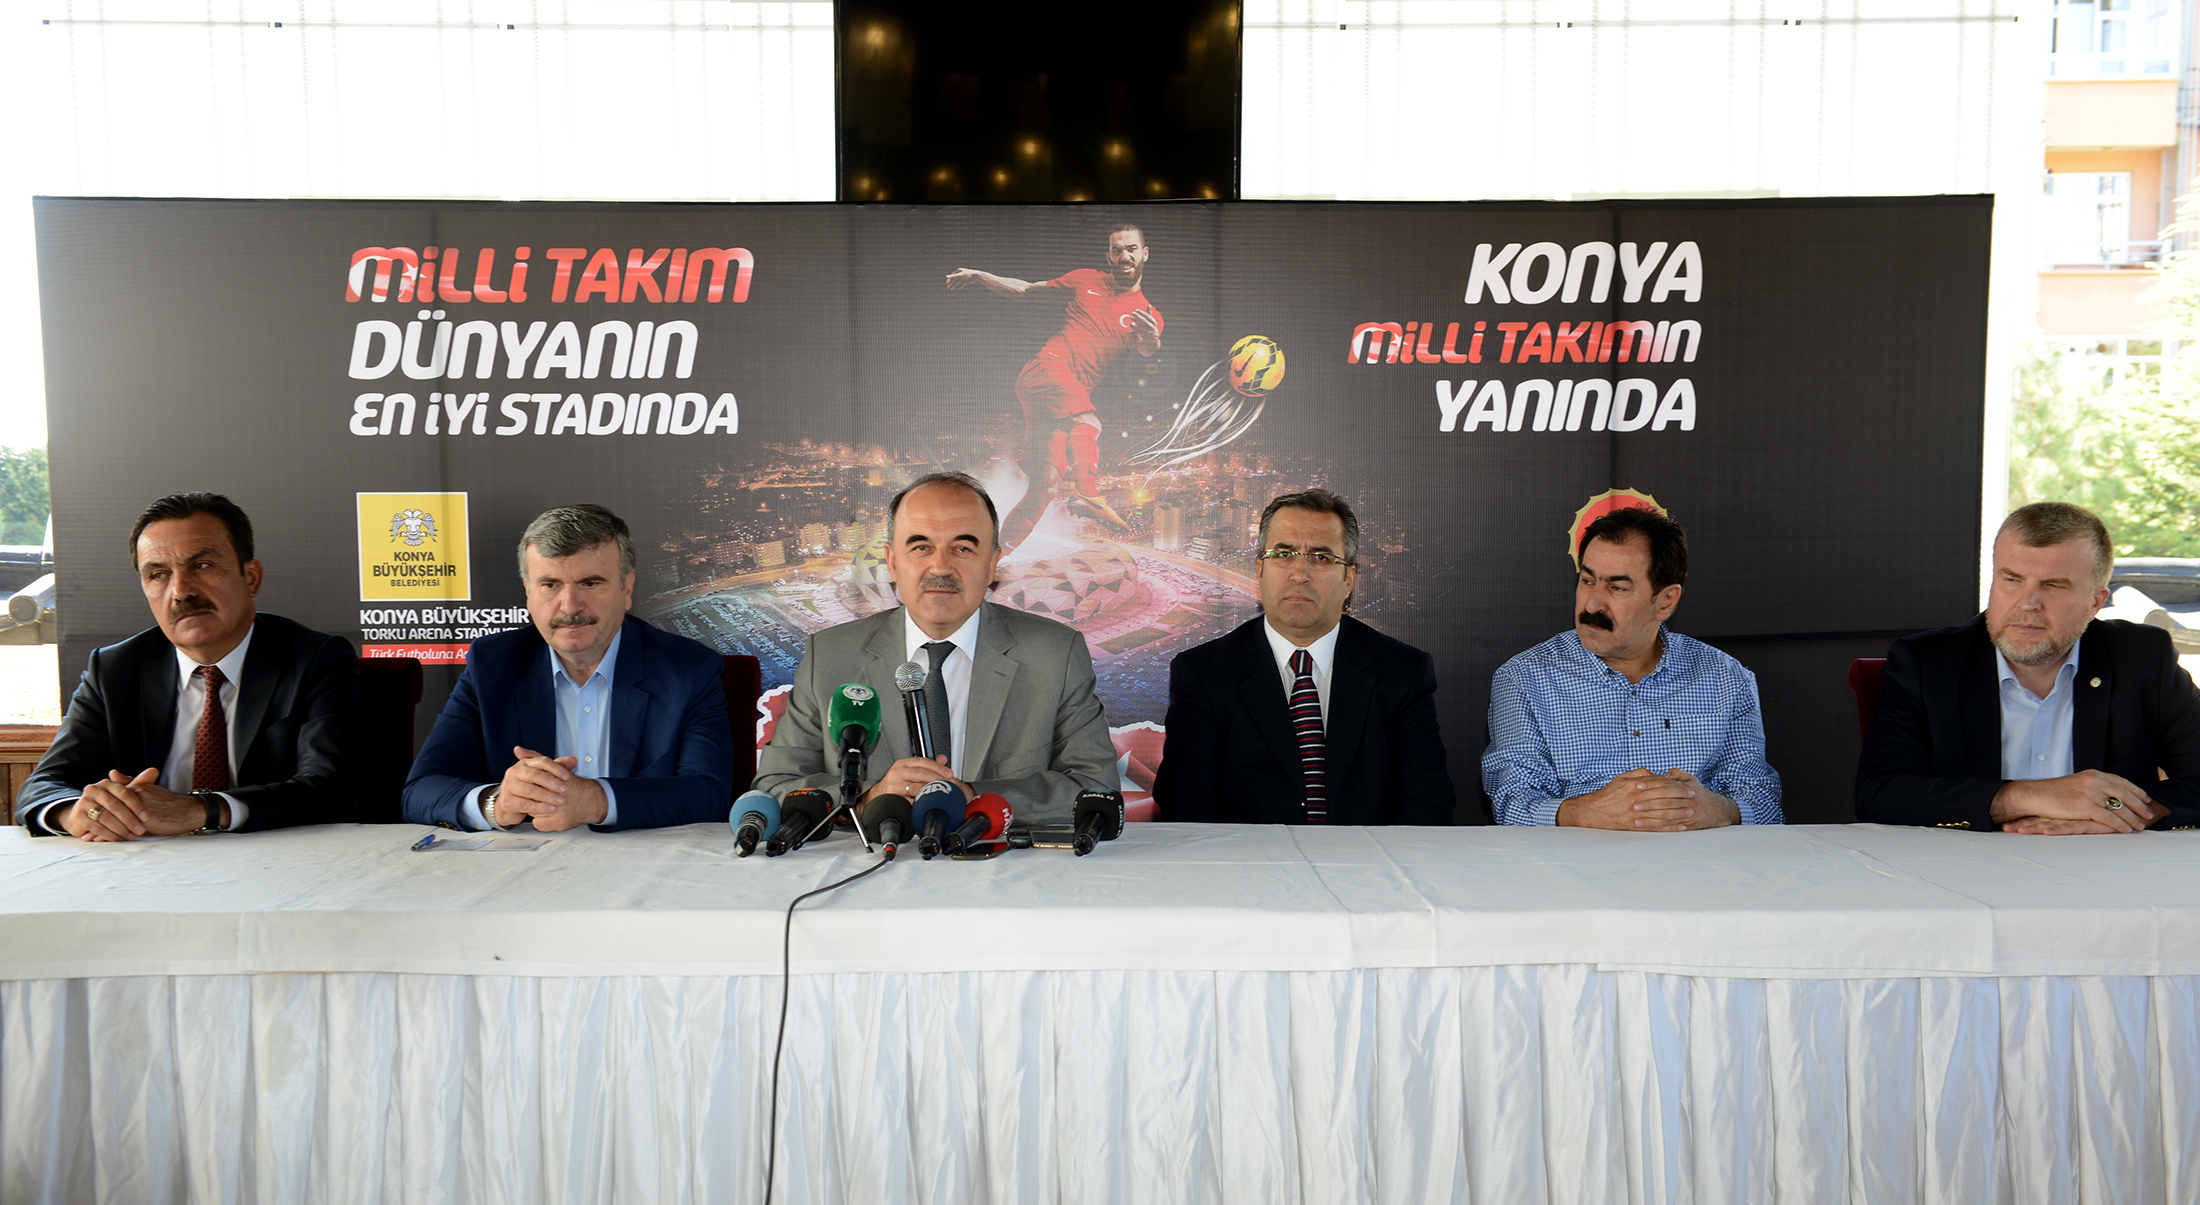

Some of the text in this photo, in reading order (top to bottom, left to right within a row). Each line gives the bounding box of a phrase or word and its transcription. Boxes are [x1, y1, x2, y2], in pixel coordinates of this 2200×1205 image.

[546, 247, 755, 303] TAKIM
[1464, 241, 1703, 304] KONYA
[348, 309, 699, 380] DÜNYANIN
[1497, 319, 1702, 364] TAKIMIN
[349, 392, 416, 436] EN
[495, 392, 739, 436] STADINDA
[1435, 378, 1697, 432] YANINDA
[373, 562, 457, 578] BÜYÜKŞEHİR
[394, 551, 436, 562] KONYA
[390, 578, 440, 587] BELEDİYESİ
[360, 606, 530, 627] KONYA BÜYÜKŞEHİR
[361, 628, 406, 640] TORKU
[408, 628, 453, 640] ARENA
[370, 648, 395, 658] Türk
[396, 648, 454, 660] Futboluna
